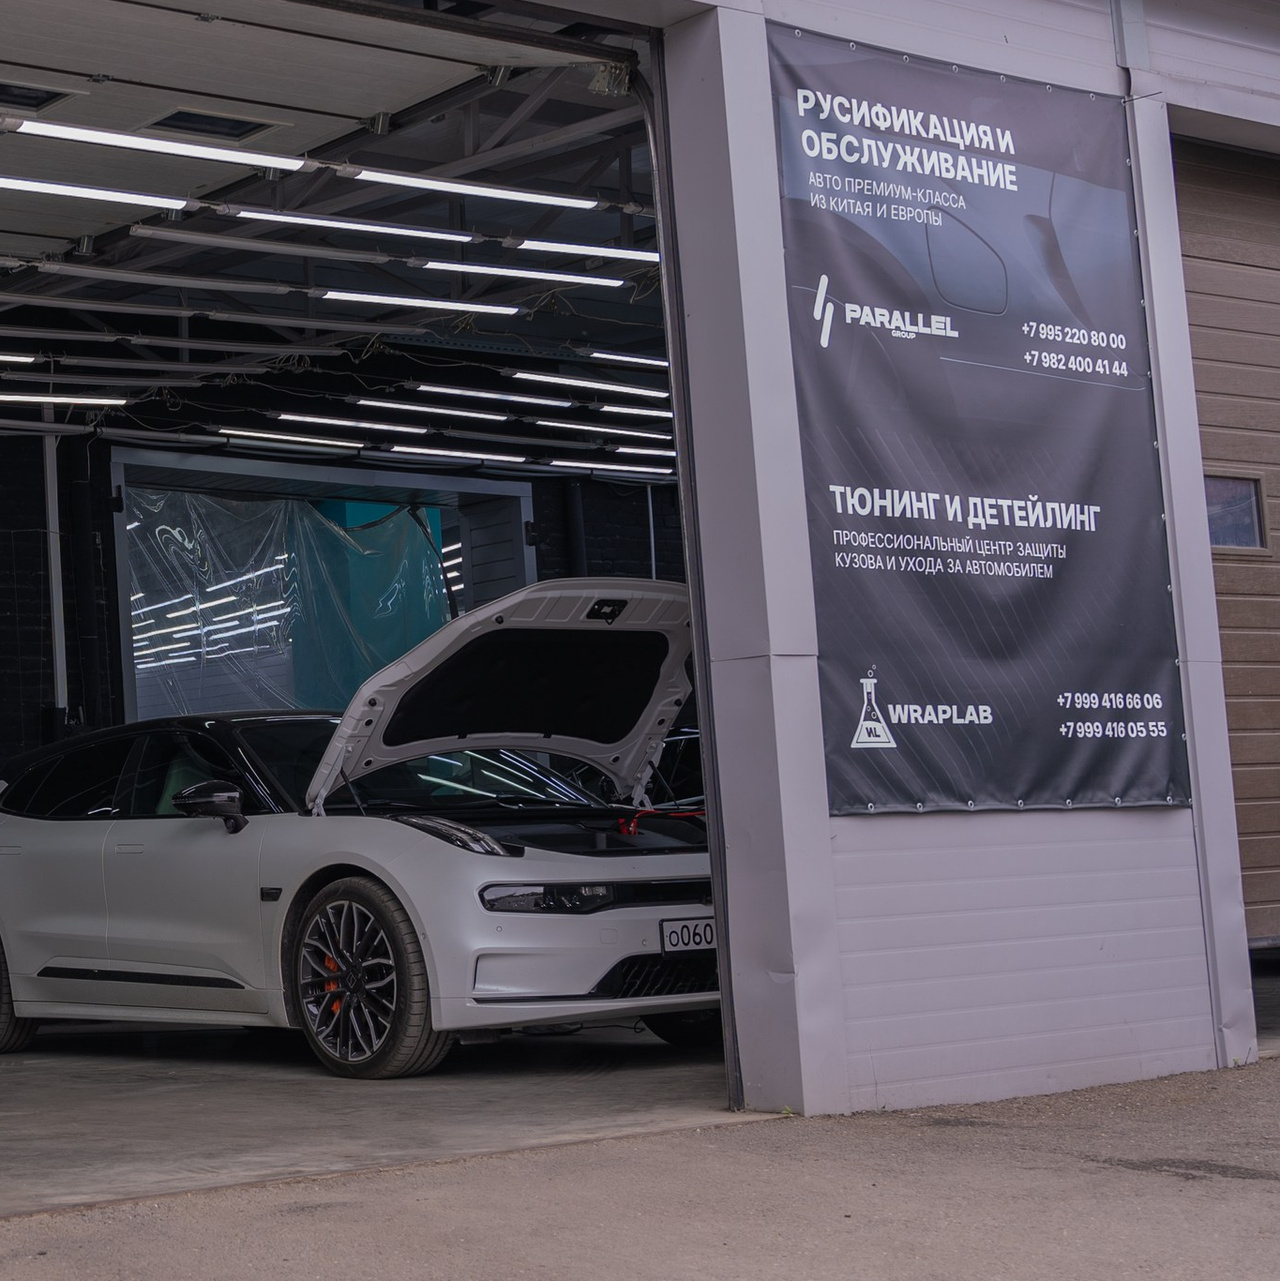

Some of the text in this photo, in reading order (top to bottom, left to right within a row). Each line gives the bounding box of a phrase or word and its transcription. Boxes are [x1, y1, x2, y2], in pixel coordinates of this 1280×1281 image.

[797, 89, 1015, 154] РУСИФИКАЦИЯ И
[801, 129, 1018, 191] ОБСЛУЖИВАНИЕ
[808, 172, 966, 209] АВТО ПРЕМИУМ-КЛАССА
[810, 193, 942, 226] ИЗ КИТАЯ И ЕВРОПЫ
[845, 303, 959, 338] PARALLEL
[891, 330, 916, 340] GROUP
[1022, 321, 1126, 350] +7 995 220 80 00
[1024, 350, 1128, 377] +7 982 400 41 44
[829, 484, 1101, 532] ТЮНИНГ И ДЕТЕЙЛИНГ
[833, 530, 1067, 560] ПРОФЕССИОНАЛЬНЫЙ ЦЕНТР ЗАЩИТЫ
[835, 552, 1053, 579] КУЗОВА И УХОДА ЗА АВТОМОБИЛЕМ
[888, 704, 993, 724] WRAPLAB
[1057, 692, 1163, 709] +7 999 416 66 06
[1059, 721, 1167, 738] +7 999 416 05 55
